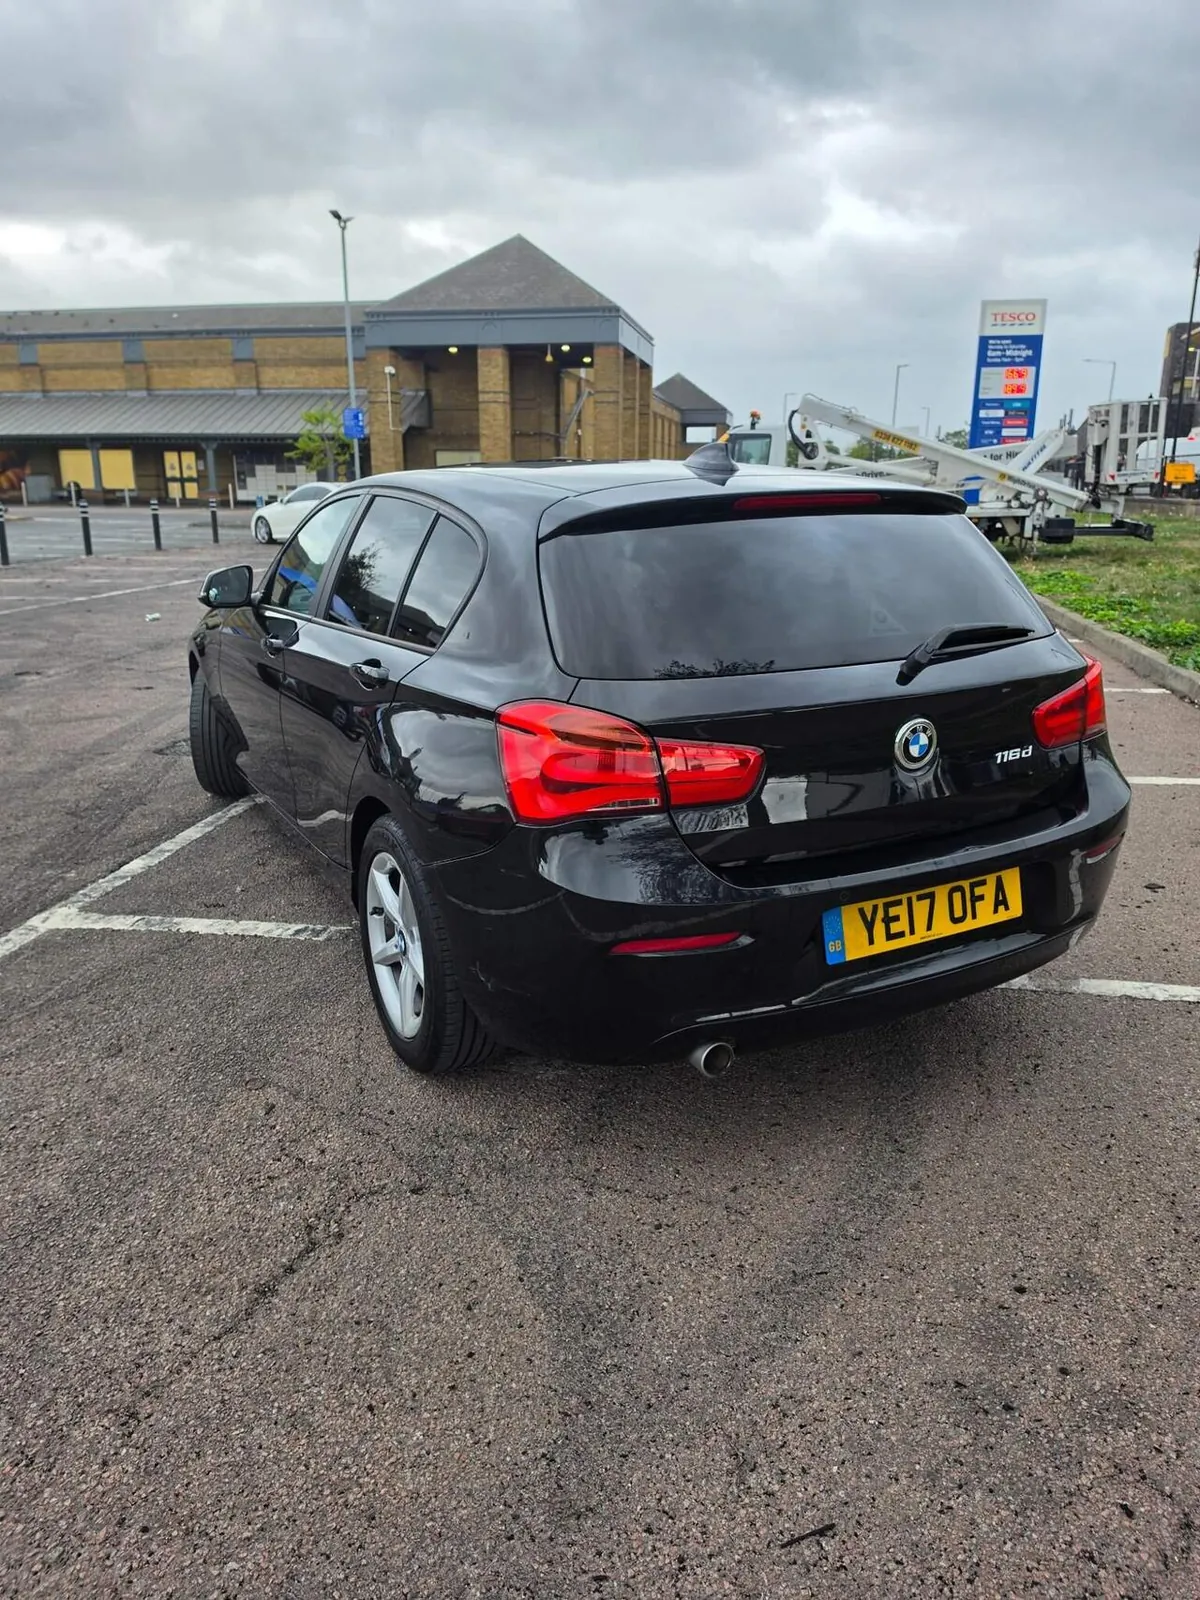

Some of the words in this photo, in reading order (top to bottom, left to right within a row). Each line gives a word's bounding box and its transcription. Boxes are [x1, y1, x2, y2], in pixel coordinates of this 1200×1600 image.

[990, 312, 1036, 322] TESCO
[1005, 349, 1033, 357] Midnight
[990, 453, 1003, 461] for
[906, 725, 932, 740] BMW
[858, 890, 936, 946] YE17
[947, 875, 1010, 924] OFA
[829, 940, 841, 952] GB
